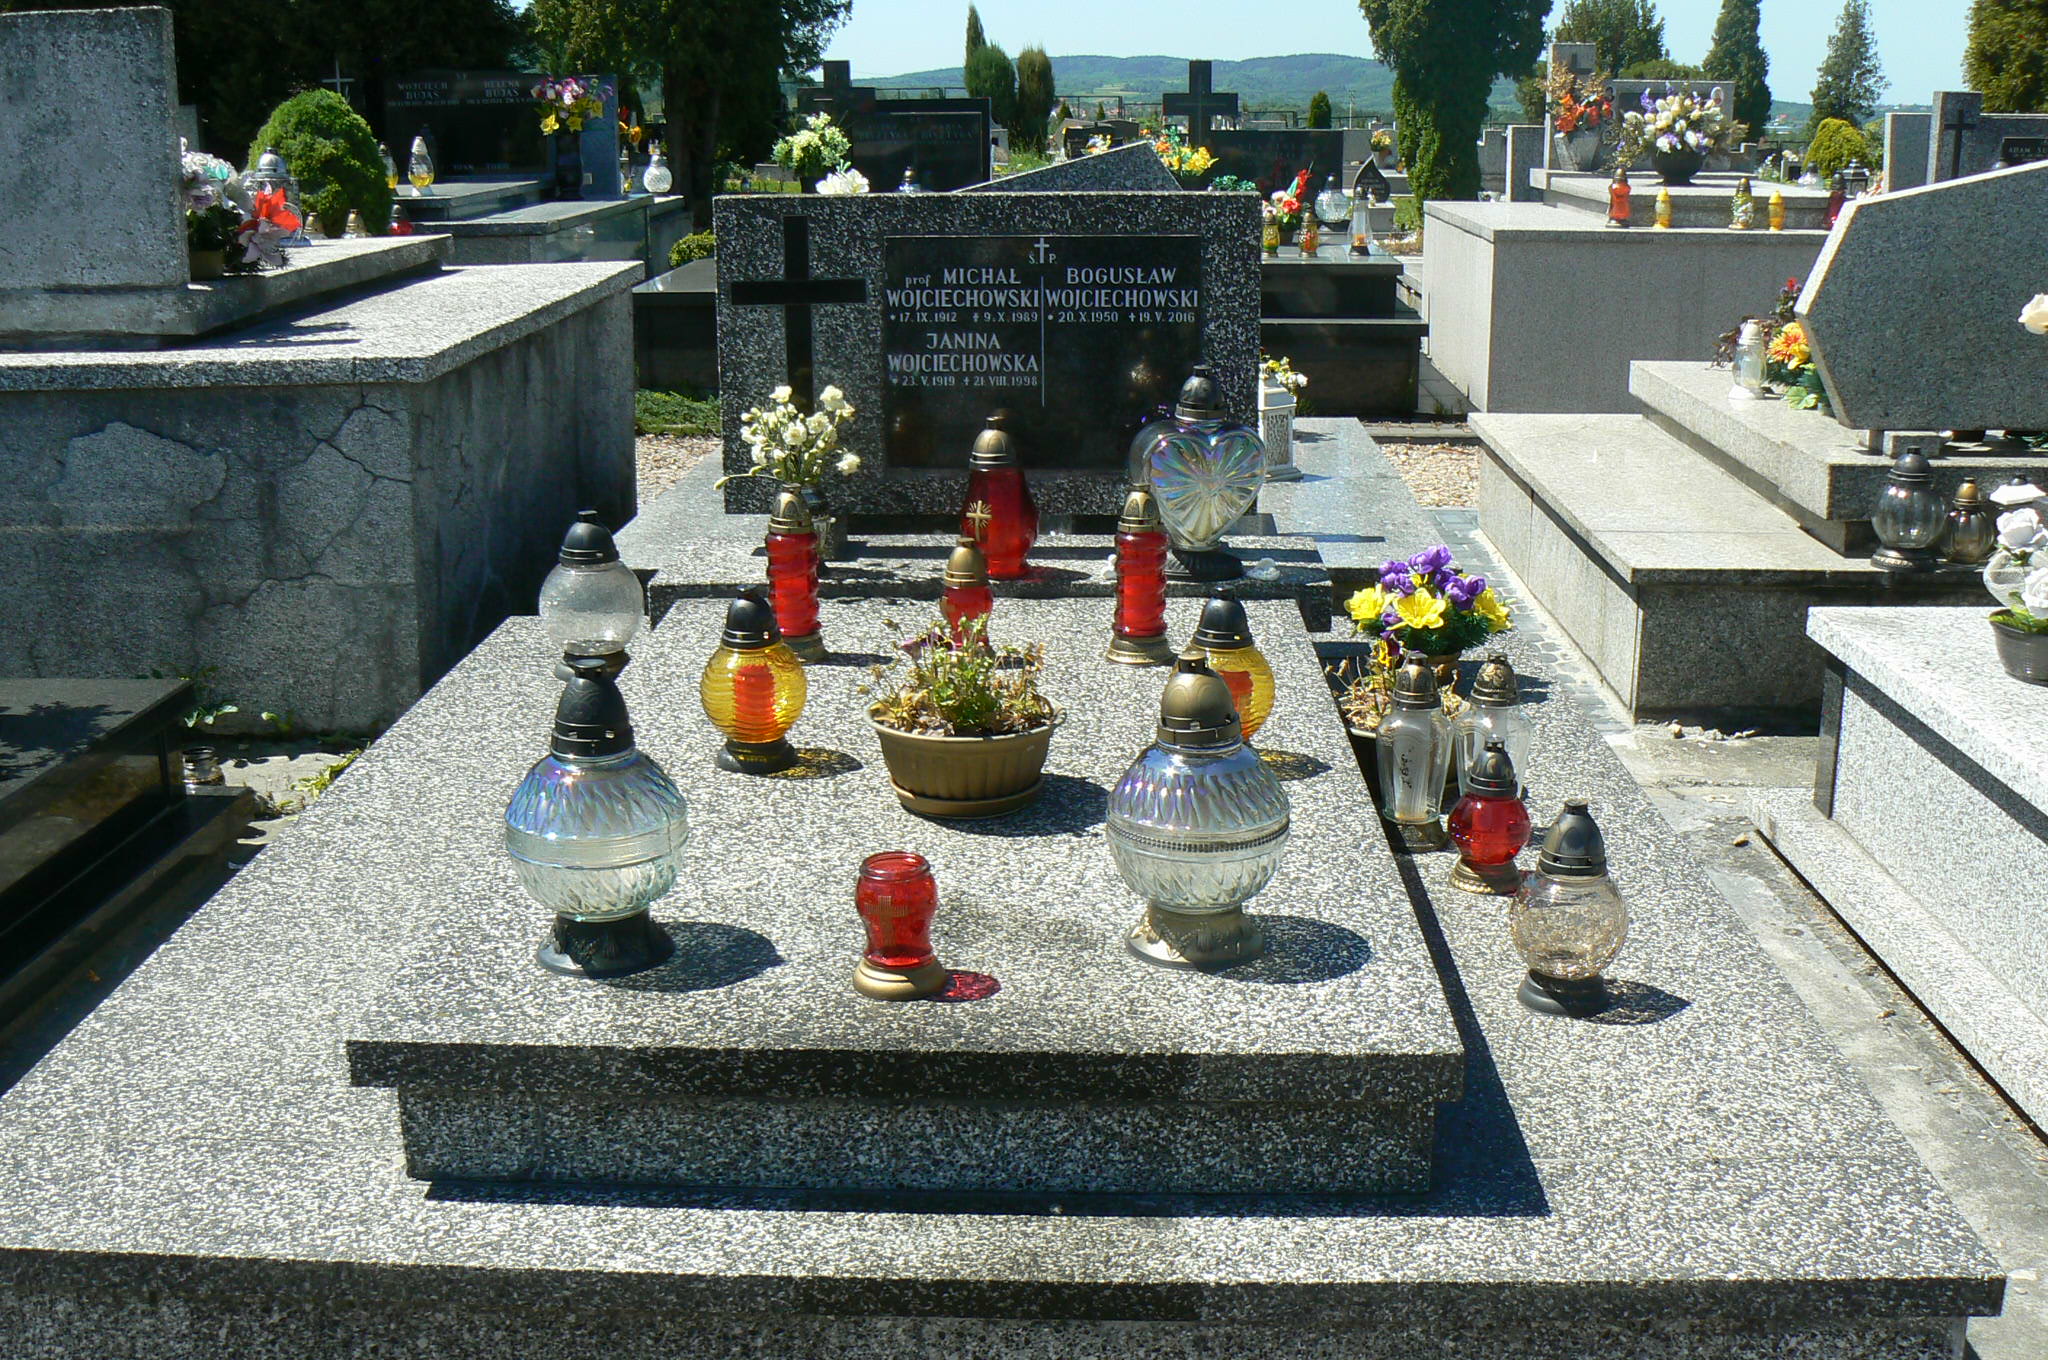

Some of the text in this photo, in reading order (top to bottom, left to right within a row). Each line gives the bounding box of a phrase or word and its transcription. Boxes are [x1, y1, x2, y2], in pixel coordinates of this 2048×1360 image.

[905, 268, 1021, 289] prof MICHAŁ
[1066, 267, 1177, 285] BOGUSŁAW
[886, 289, 1040, 311] WOJCIECHOWSKI
[1045, 289, 1199, 311] WOJCIECHOWSKI
[926, 332, 1001, 350] JANINA
[887, 353, 1040, 374] WOJCIECHOWSKA
